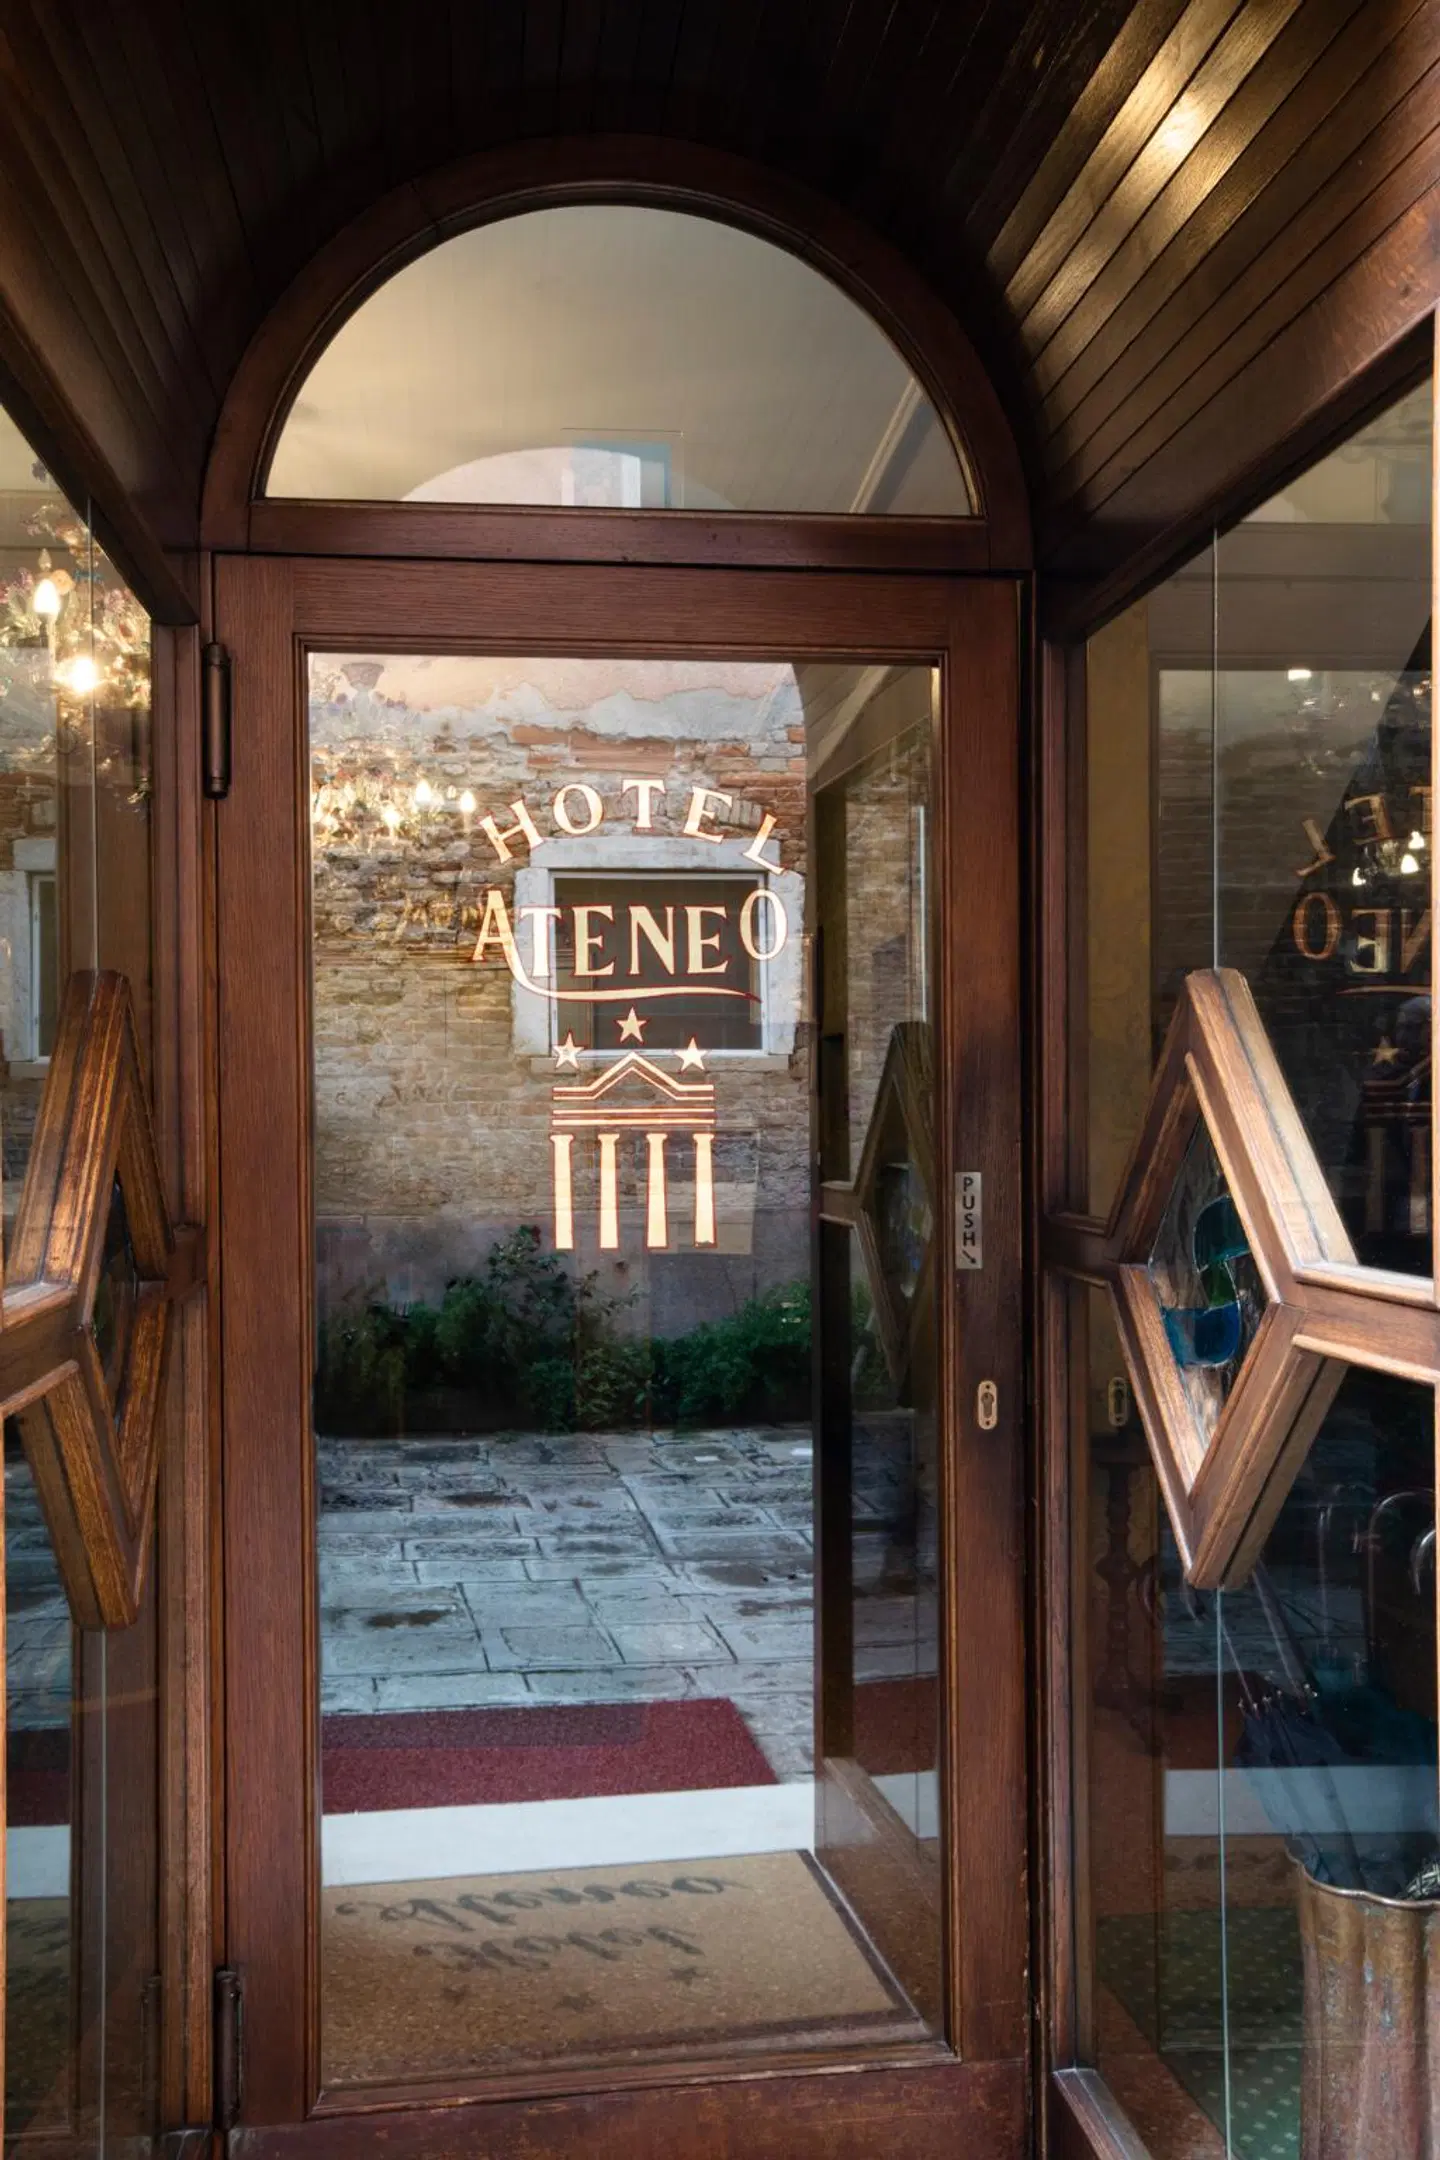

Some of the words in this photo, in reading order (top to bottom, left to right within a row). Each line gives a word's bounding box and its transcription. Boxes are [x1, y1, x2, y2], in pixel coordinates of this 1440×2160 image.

[478, 777, 787, 876] HOTEL
[471, 887, 789, 1002] ATENEO
[962, 1176, 976, 1247] PUSH
